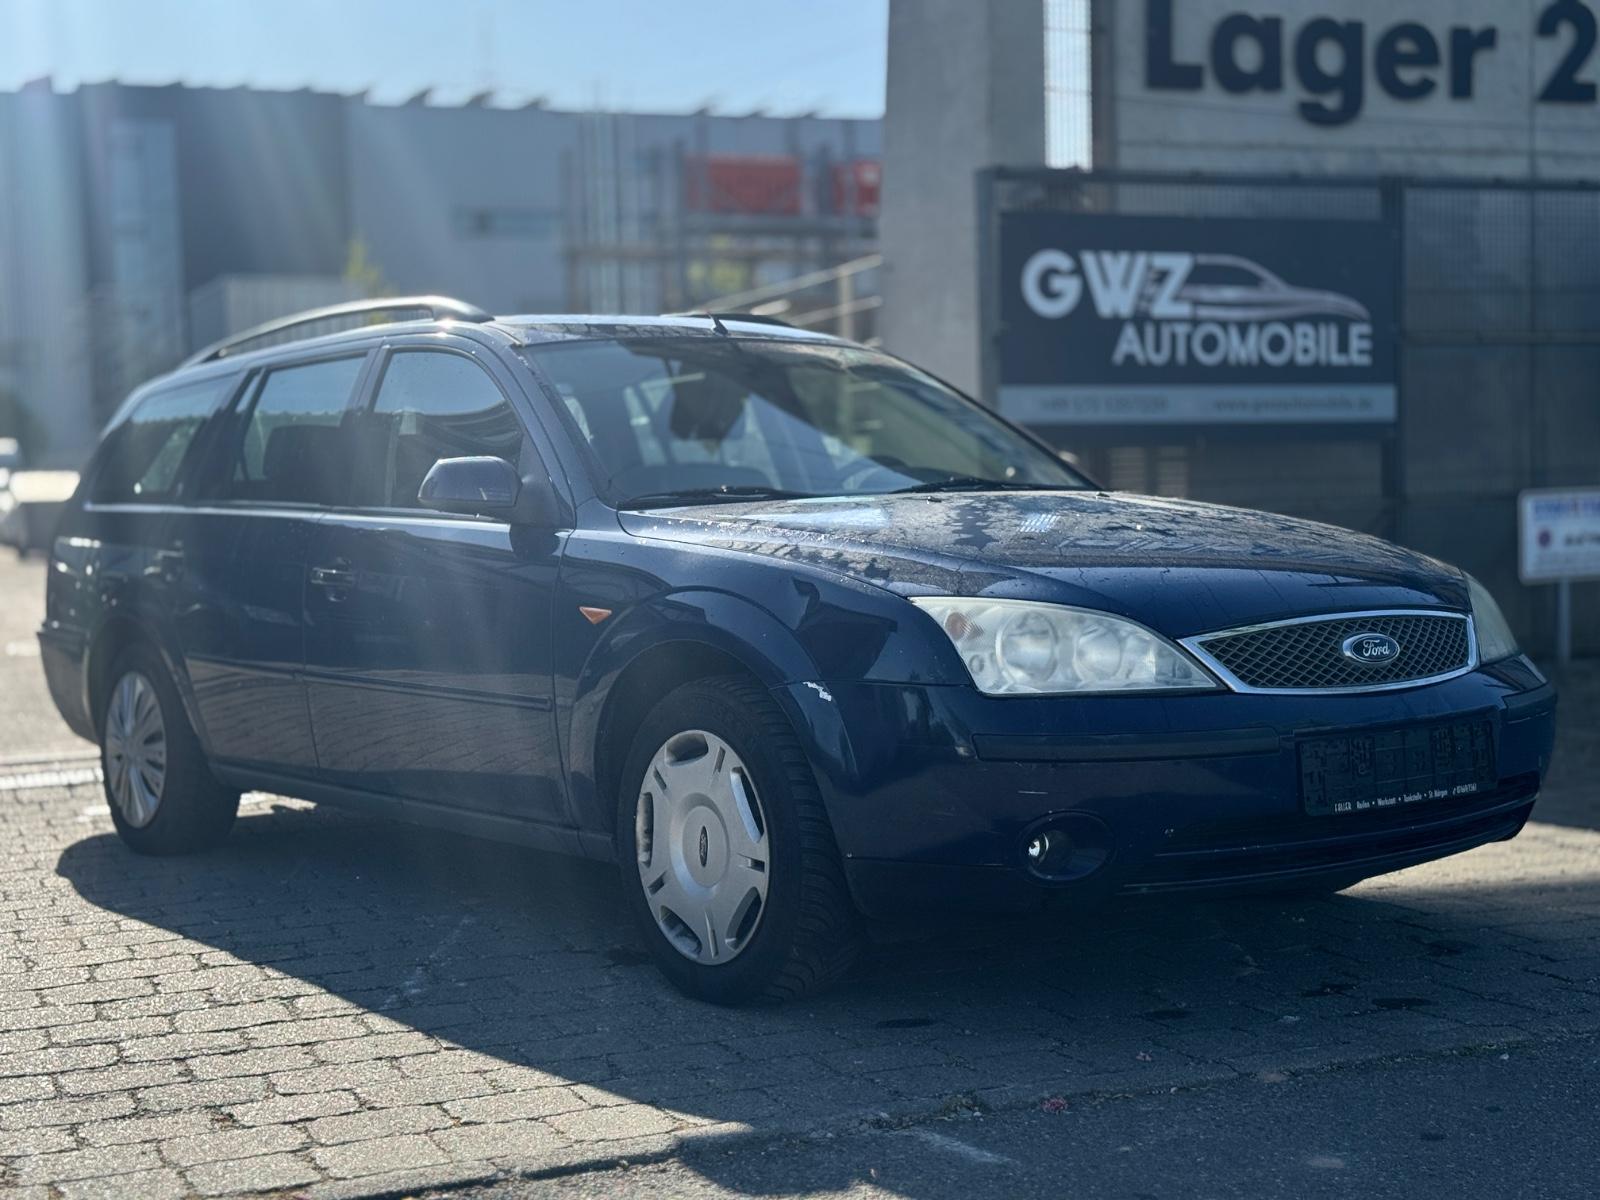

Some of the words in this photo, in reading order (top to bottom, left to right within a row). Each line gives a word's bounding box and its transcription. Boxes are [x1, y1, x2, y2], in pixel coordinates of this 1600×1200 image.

[1144, 0, 1499, 129] Lager
[1533, 0, 1599, 107] 2
[1021, 248, 1194, 319] GWZ
[1112, 322, 1372, 367] AUTOMOBILE
[1362, 639, 1391, 657] Ford
